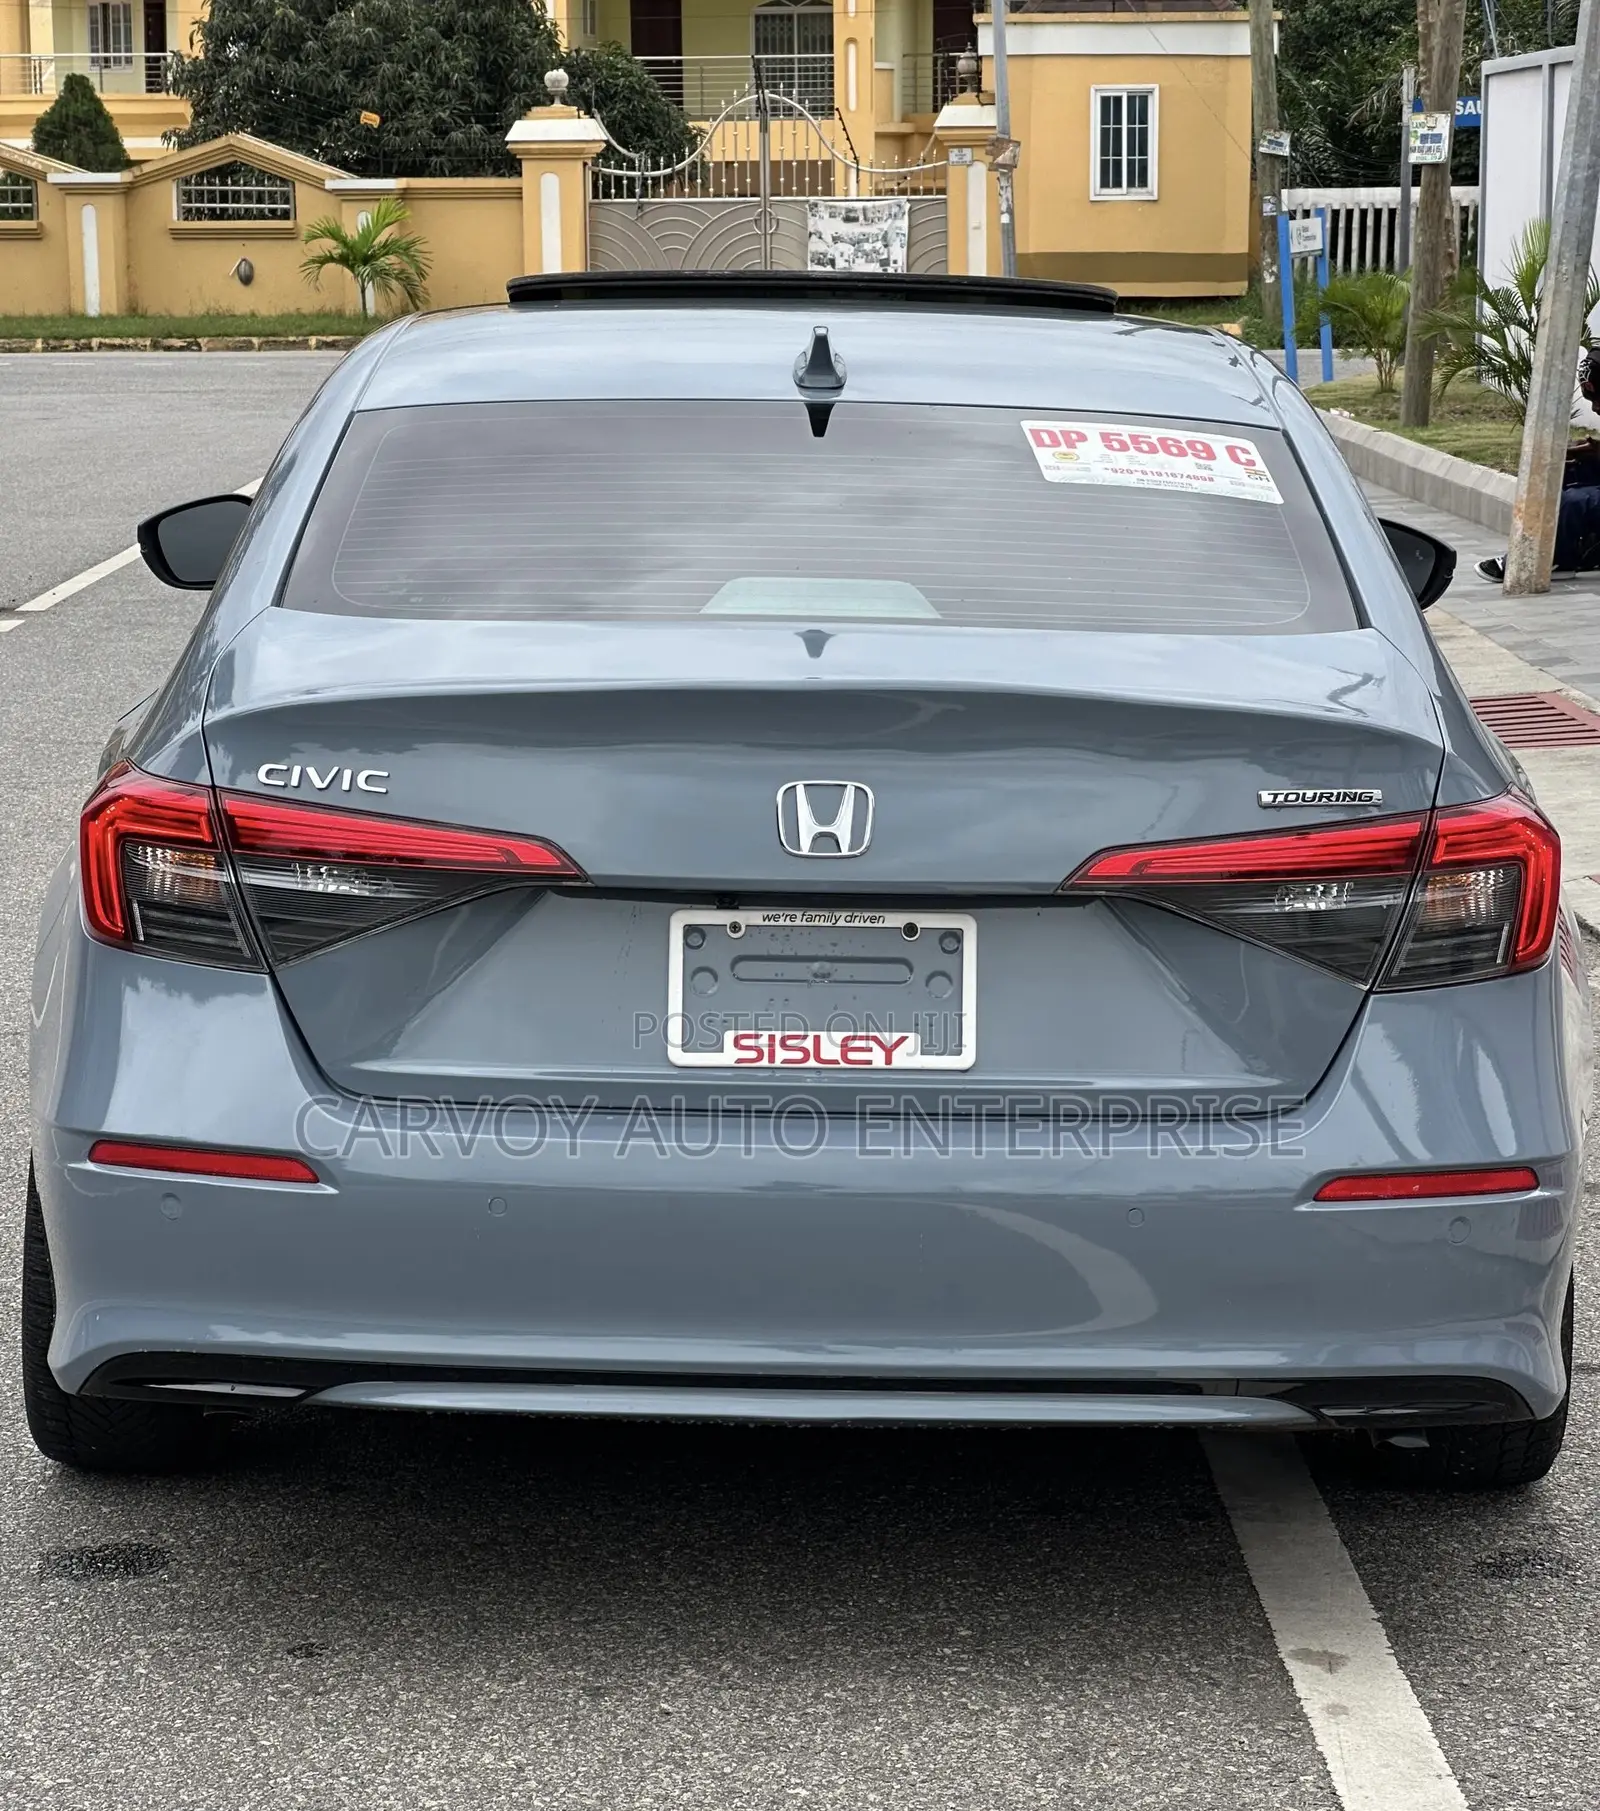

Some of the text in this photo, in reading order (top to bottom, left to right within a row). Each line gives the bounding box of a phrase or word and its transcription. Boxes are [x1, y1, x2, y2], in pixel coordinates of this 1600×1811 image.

[1028, 428, 1088, 449] DP
[1099, 431, 1217, 461] 5569
[1225, 445, 1256, 467] C
[257, 763, 389, 793] CIVIC
[1267, 791, 1374, 804] TOURING
[762, 911, 886, 926] we're family driven
[733, 1033, 909, 1066] SISLEY
